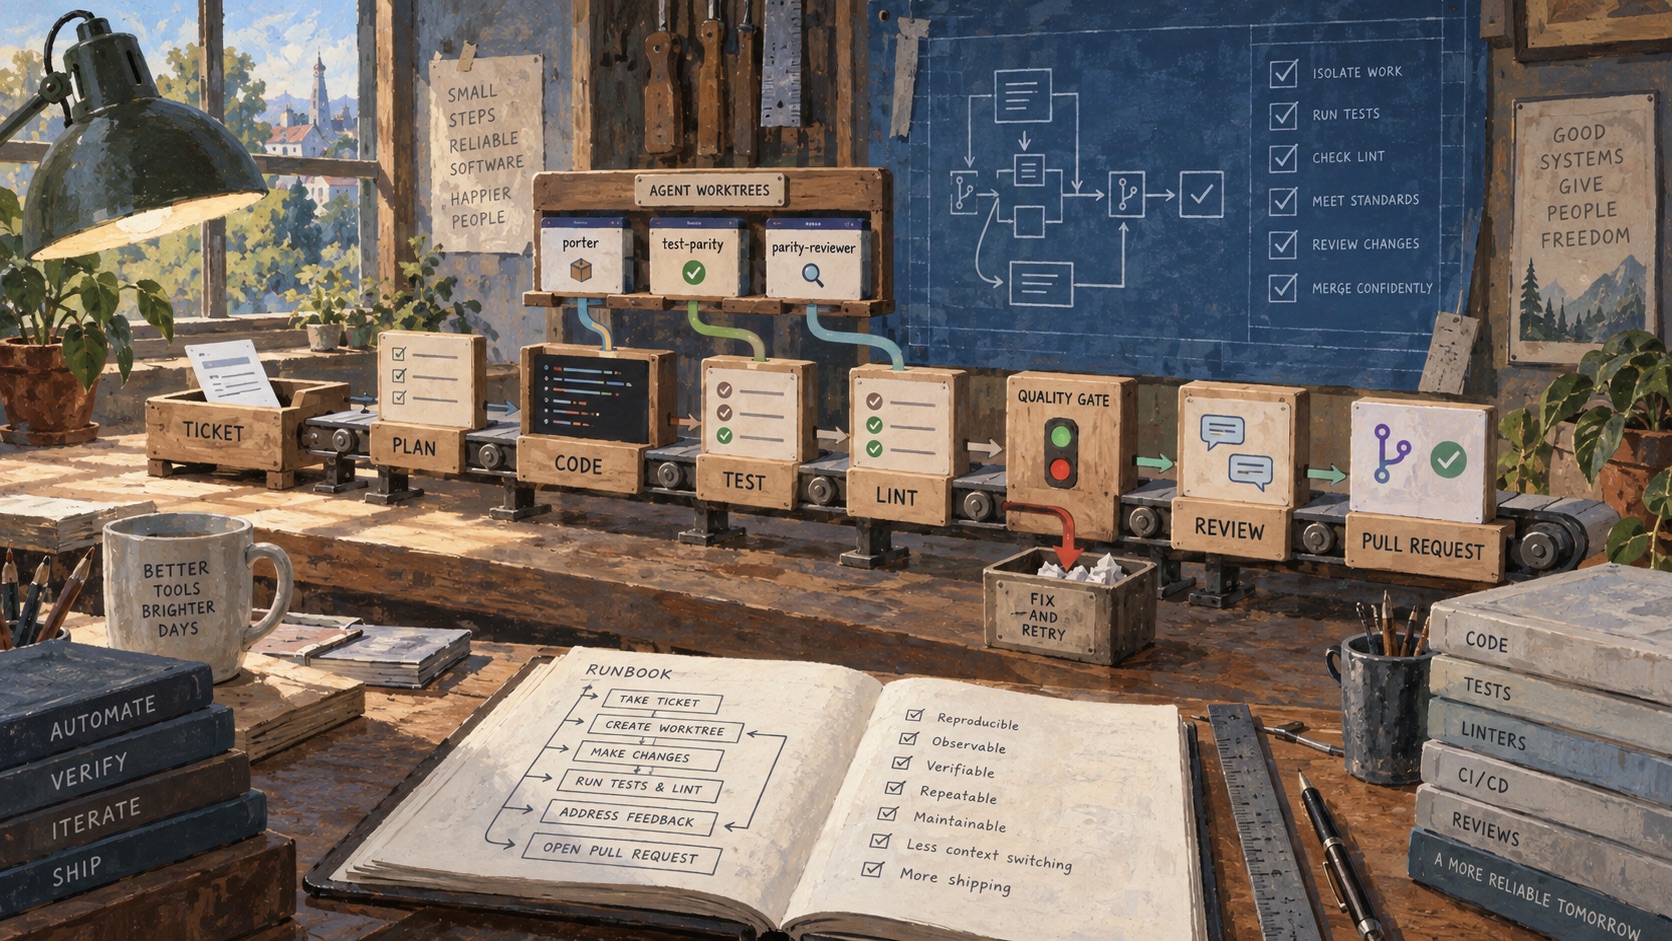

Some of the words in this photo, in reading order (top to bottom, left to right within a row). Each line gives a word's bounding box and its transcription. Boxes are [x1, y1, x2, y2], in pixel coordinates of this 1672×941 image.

[1313, 67, 1361, 79] ISOLATE
[1367, 66, 1403, 77] WORK
[448, 83, 498, 103] SMALL
[448, 111, 496, 128] STEPS
[1313, 109, 1339, 120] RUN
[1343, 108, 1380, 119] TESTS
[449, 131, 518, 153] RELIABLE
[1553, 124, 1606, 143] GOOD
[450, 155, 524, 176] SOFTWARE
[1313, 151, 1351, 163] CHECK
[1357, 150, 1385, 162] LINT
[1540, 148, 1624, 170] SYSTEMS
[649, 184, 693, 197] AGENT
[696, 184, 770, 197] WORKTREES
[1559, 176, 1603, 195] GIVE
[450, 185, 512, 207] HAPPIER
[1313, 195, 1347, 207] MEET
[1351, 194, 1419, 206] STANDARDS
[452, 210, 505, 230] PEOPLE
[1547, 201, 1617, 222] PEOPLE
[562, 237, 599, 251] porter
[662, 237, 724, 254] test-parity
[1313, 238, 1359, 251] REVIEW
[1364, 238, 1420, 250] CHANGES
[1541, 227, 1630, 249] FREEDOM
[772, 241, 856, 257] parity-reviewer
[1313, 282, 1352, 294] MERGE
[1356, 281, 1433, 294] CONFIDENTLY
[1018, 388, 1072, 405] QUALITY
[1078, 392, 1110, 407] GATE
[182, 421, 244, 442] TICKET
[392, 438, 436, 457] PLAN
[555, 454, 603, 475] CODE
[723, 471, 766, 492] TEST
[876, 487, 918, 506] LINT
[1195, 517, 1265, 541] REVIEW
[1363, 533, 1403, 553] PULL
[1409, 536, 1485, 561] REQUEST
[144, 561, 209, 578] BETTER
[153, 582, 200, 597] TOOLS
[142, 600, 216, 618] BRIGHTER
[1030, 593, 1055, 607] FIX
[1029, 609, 1058, 623] AND
[158, 622, 199, 638] DAYS
[1022, 624, 1066, 641] RETRY
[1466, 631, 1508, 653] CODE
[586, 664, 672, 680] RUNBOOK
[1464, 677, 1511, 701] TESTS
[619, 695, 650, 706] TAKE
[657, 697, 700, 708] TICKET
[50, 695, 156, 742] AUTOMATE
[605, 720, 652, 732] CREATE
[659, 724, 725, 736] WORKTREE
[937, 712, 1019, 731] Reproducible
[932, 736, 1006, 754] Observable
[1462, 721, 1526, 751] LINTERS
[591, 748, 626, 759] MAKE
[632, 751, 690, 763] CHANGES
[51, 752, 128, 791] VERIFY
[927, 760, 995, 779] Verifiable
[575, 776, 603, 787] RUN
[611, 779, 648, 791] TESTS
[655, 782, 665, 792] &
[672, 783, 702, 795] LINT
[1458, 767, 1509, 794] CI/CD
[920, 785, 997, 805] Repeatable
[52, 797, 140, 840] ITERATE
[559, 807, 619, 821] ADDRESS
[627, 813, 694, 828] FEEDBACK
[914, 811, 1007, 833] Maintainable
[1453, 812, 1520, 847] REVIEWS
[543, 842, 581, 855] OPEN
[590, 846, 623, 858] PULL
[632, 849, 698, 865] REQUEST
[907, 839, 937, 853] Less
[946, 845, 999, 860] context
[1007, 854, 1072, 875] switching
[52, 856, 101, 887] SHIP
[900, 867, 938, 884] More
[949, 874, 1011, 897] shipping
[1434, 853, 1443, 867] A
[1449, 857, 1483, 882] MORE
[1489, 873, 1550, 908] RELIABLE
[1557, 898, 1641, 941] TOMORROW
